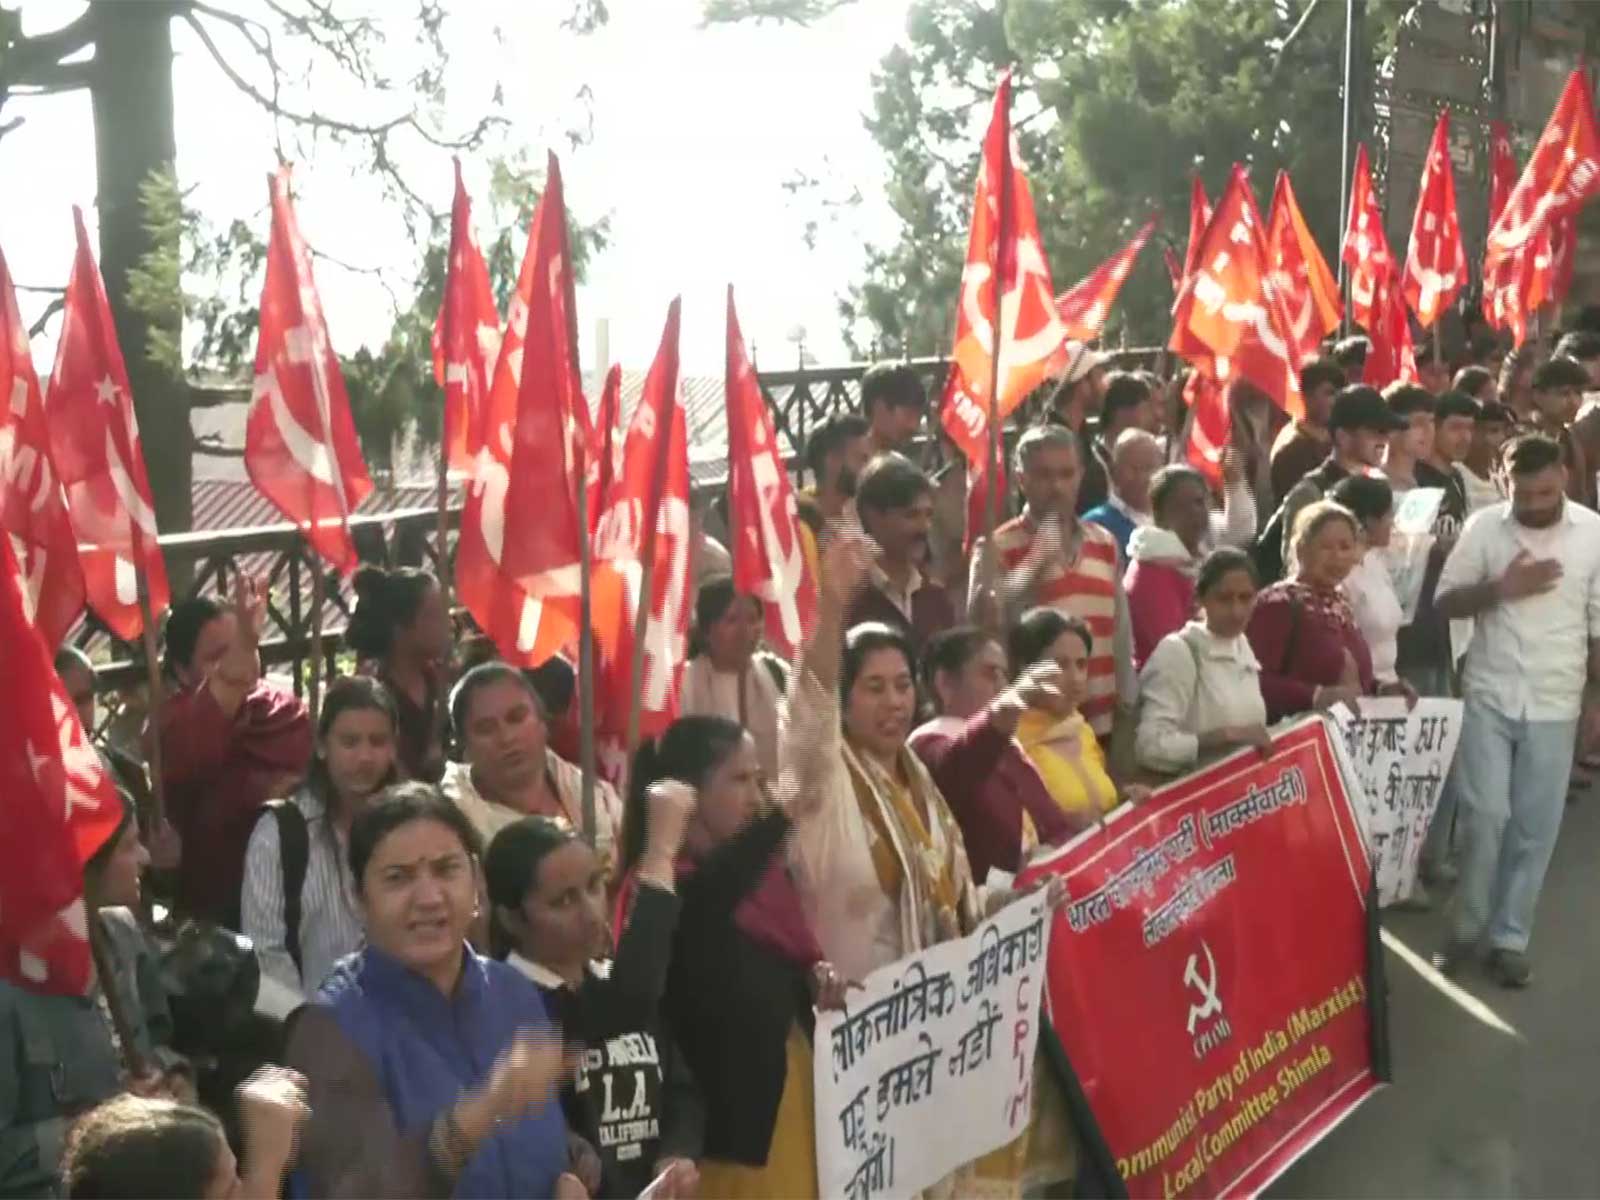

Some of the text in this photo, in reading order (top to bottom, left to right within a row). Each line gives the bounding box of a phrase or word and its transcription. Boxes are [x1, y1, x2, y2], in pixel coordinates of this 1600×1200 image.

[1117, 975, 1366, 1179] ommunist Party of India (Marxist)
[1162, 1043, 1333, 1200] Local Committee Shimla
